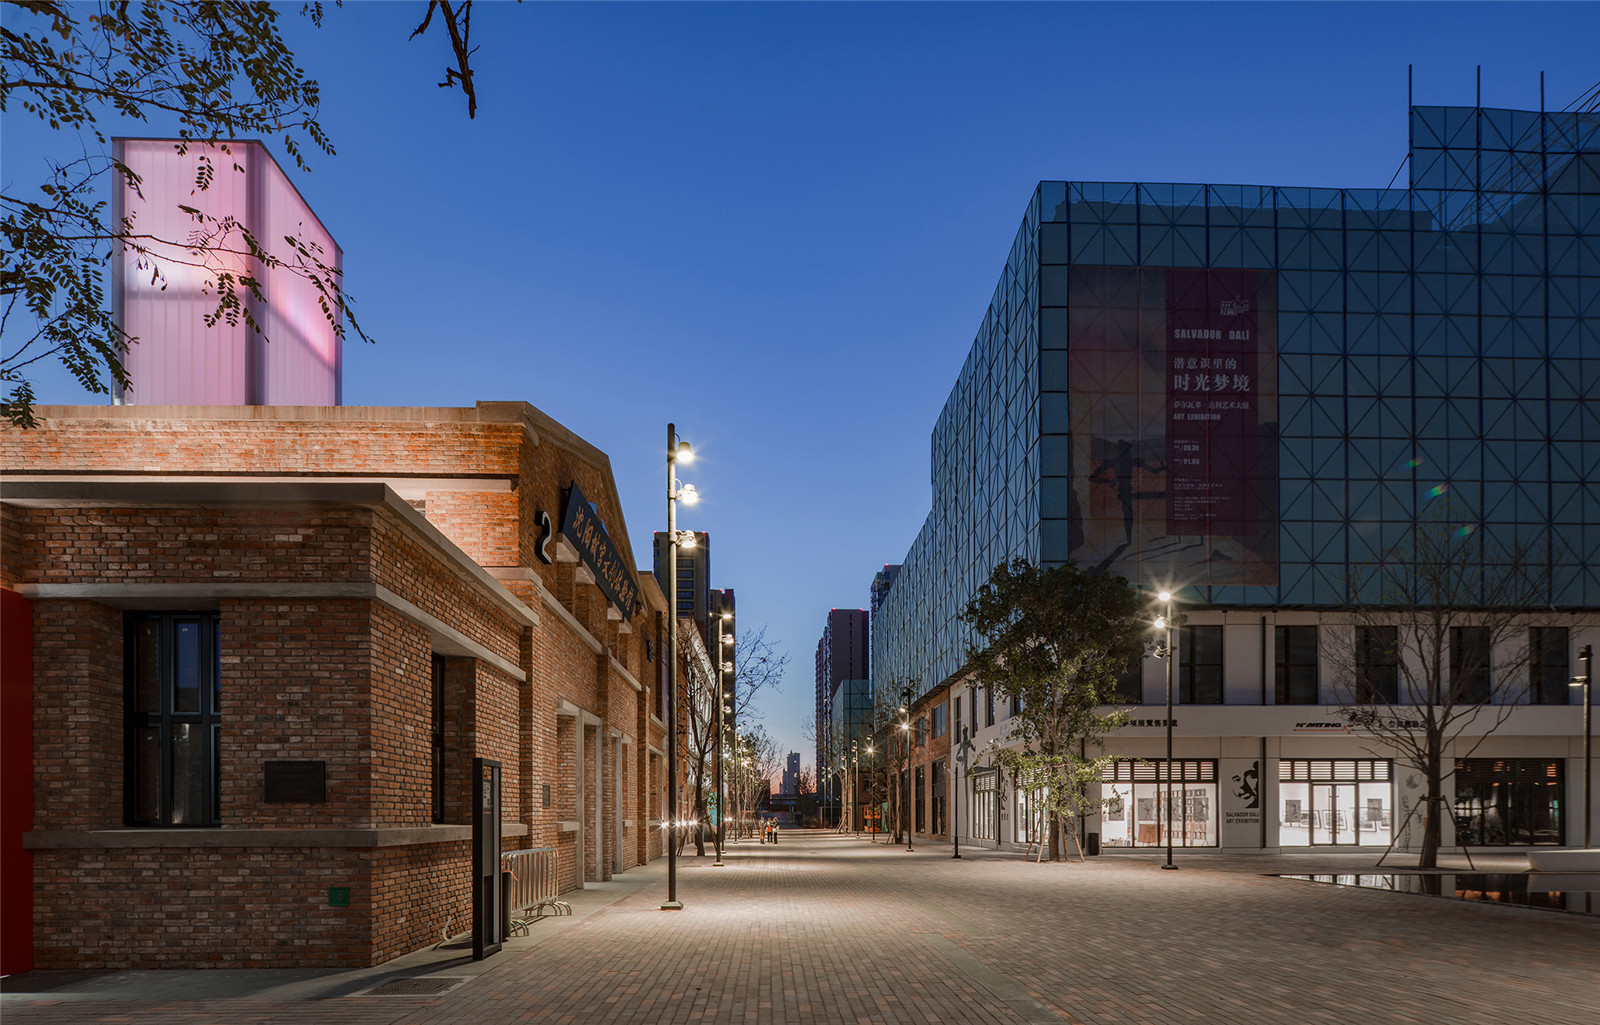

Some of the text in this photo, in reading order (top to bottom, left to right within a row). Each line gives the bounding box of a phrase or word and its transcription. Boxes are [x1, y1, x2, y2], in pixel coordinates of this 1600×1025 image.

[1174, 328, 1222, 340] SALVADOR
[1173, 356, 1237, 370] 潜意识里的
[1173, 373, 1250, 392] 时光梦境
[536, 510, 552, 565] 2
